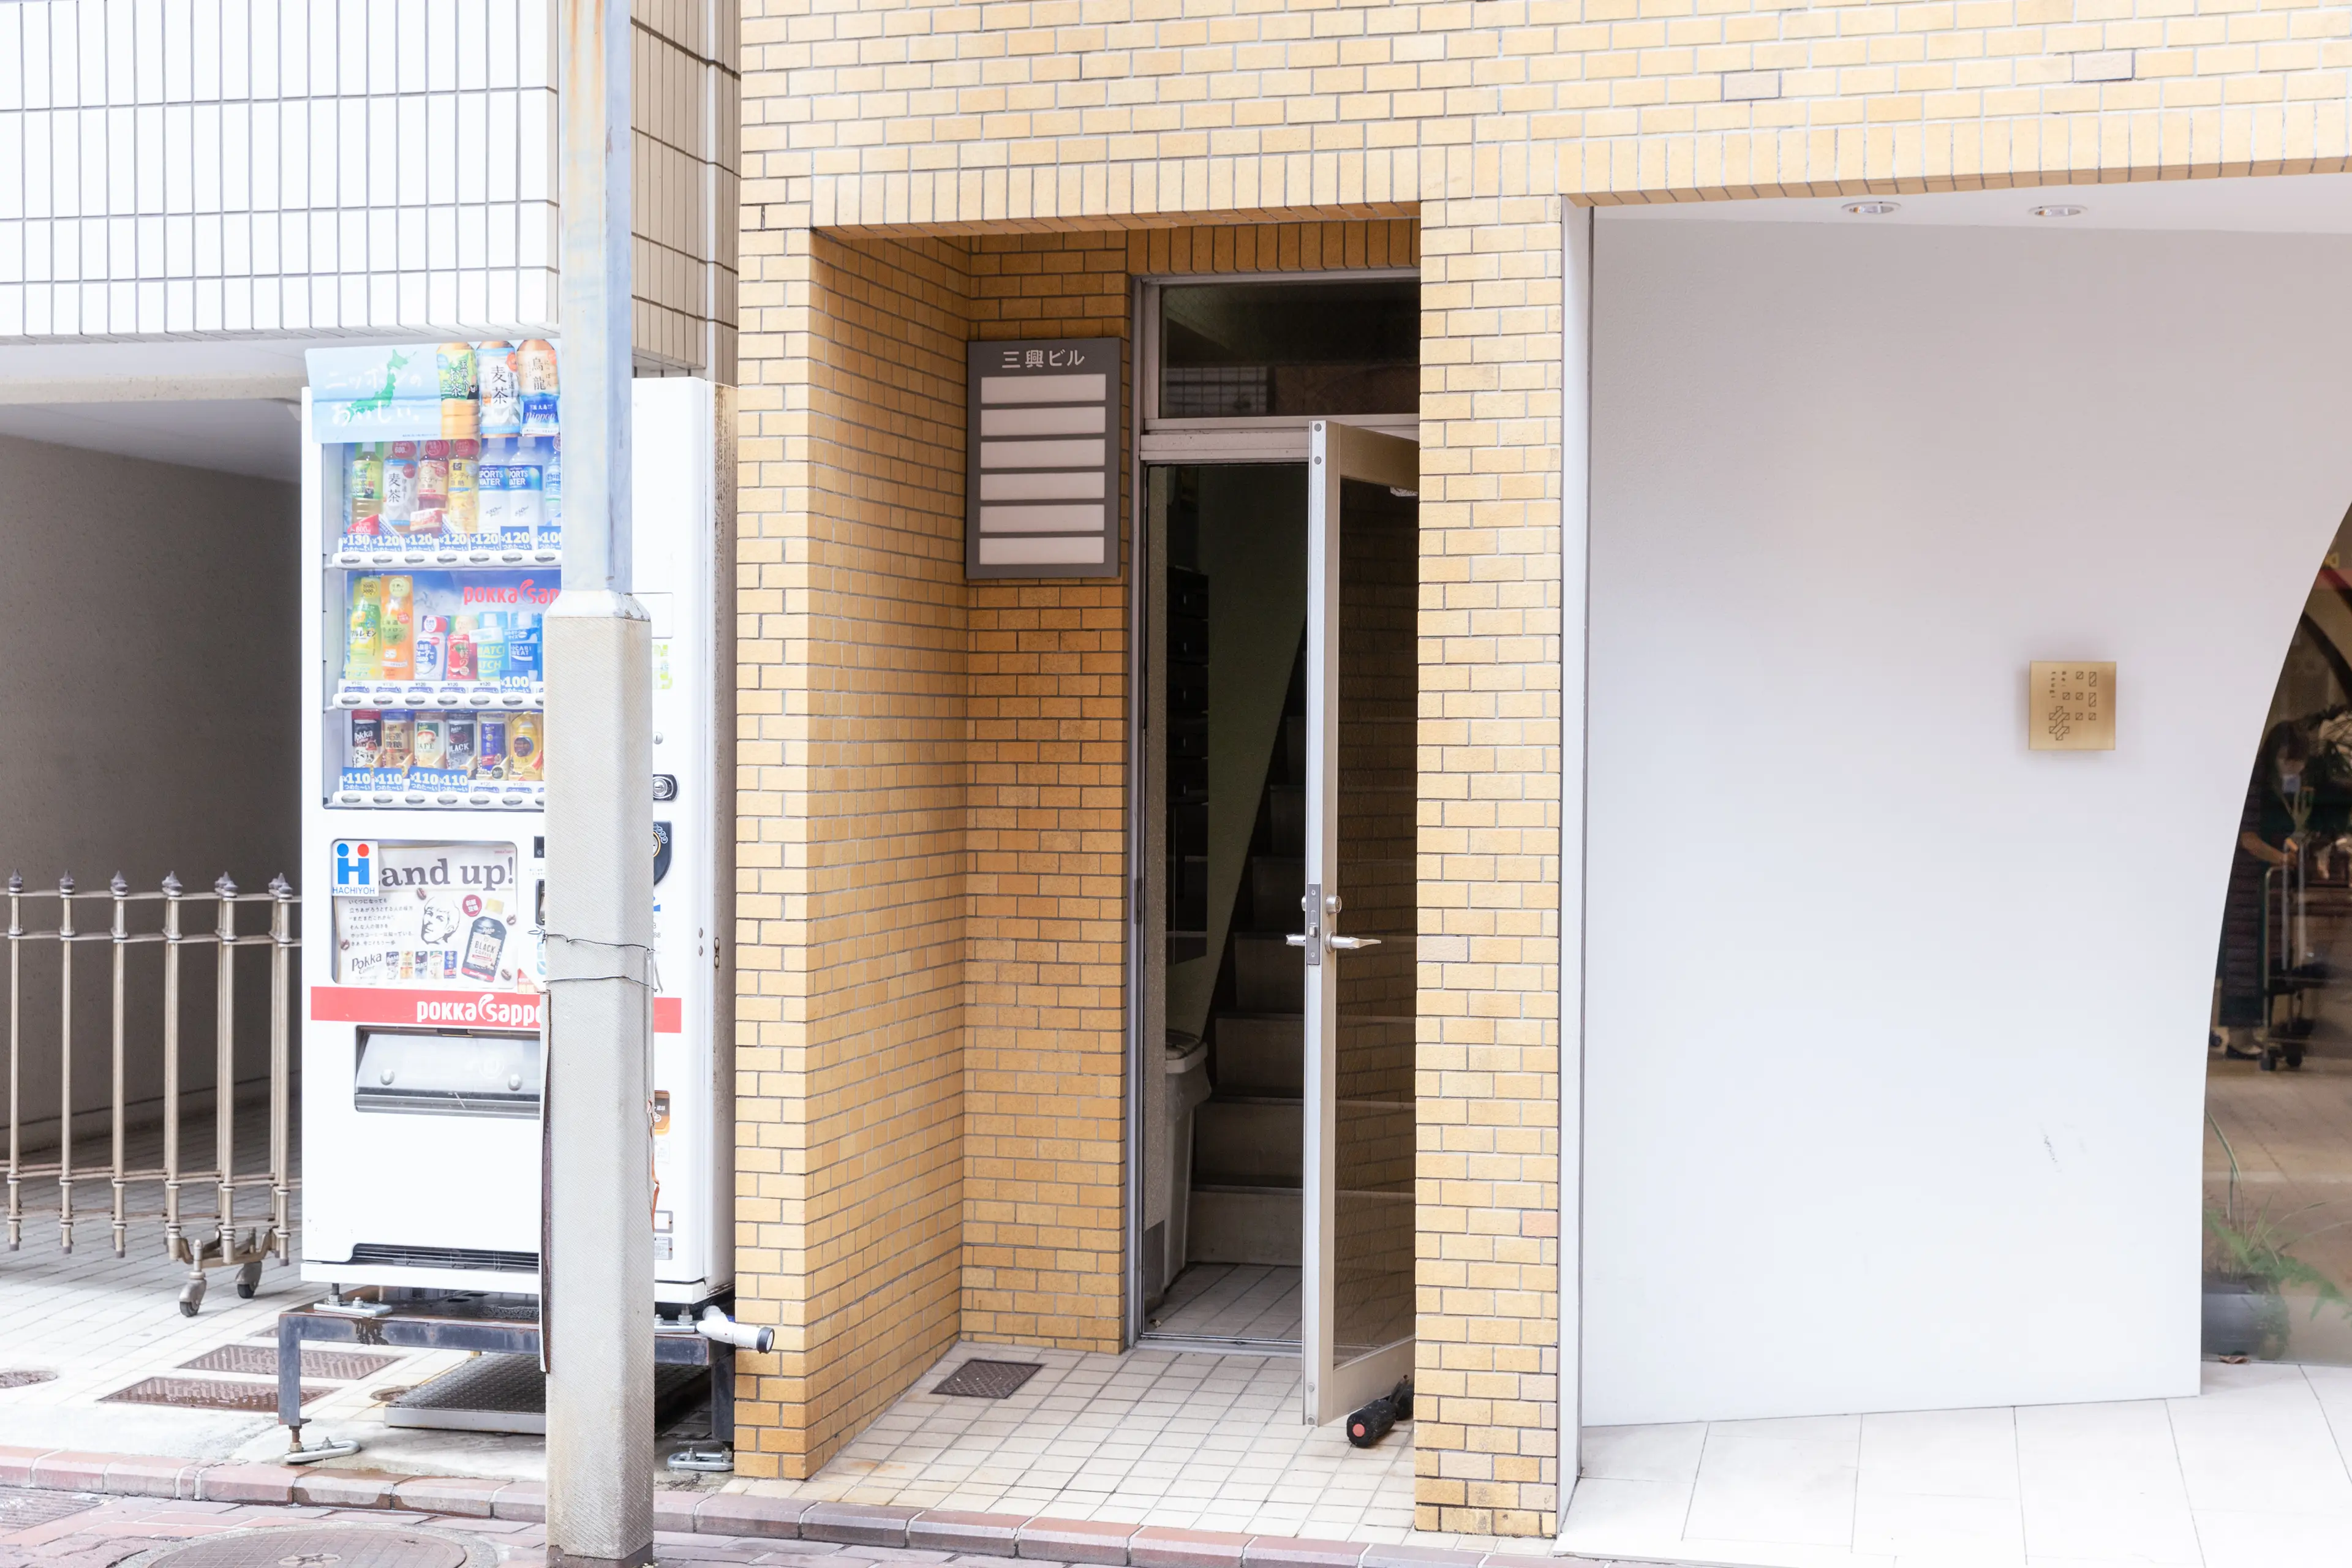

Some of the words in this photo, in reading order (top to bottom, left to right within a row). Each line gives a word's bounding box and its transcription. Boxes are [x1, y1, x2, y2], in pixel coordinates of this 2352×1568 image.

[1002, 349, 1085, 368] 三興ビル
[450, 369, 462, 397] お茶
[491, 365, 508, 404] 麦茶
[388, 473, 401, 503] 麦茶
[343, 534, 370, 545] ¥130
[372, 535, 399, 546] ¥120
[405, 535, 432, 545] ¥120
[439, 533, 467, 545] ¥120
[471, 533, 499, 545] ¥120
[501, 532, 530, 544] ¥120
[500, 676, 529, 687] ¥100
[343, 773, 371, 784] ¥110
[375, 774, 402, 785] ¥110
[410, 772, 439, 785] ¥110
[440, 775, 468, 786] ¥110
[460, 856, 513, 891] up!
[332, 886, 375, 895] HACHIYOH
[475, 941, 496, 954] BLACK
[352, 953, 382, 971] Pokka
